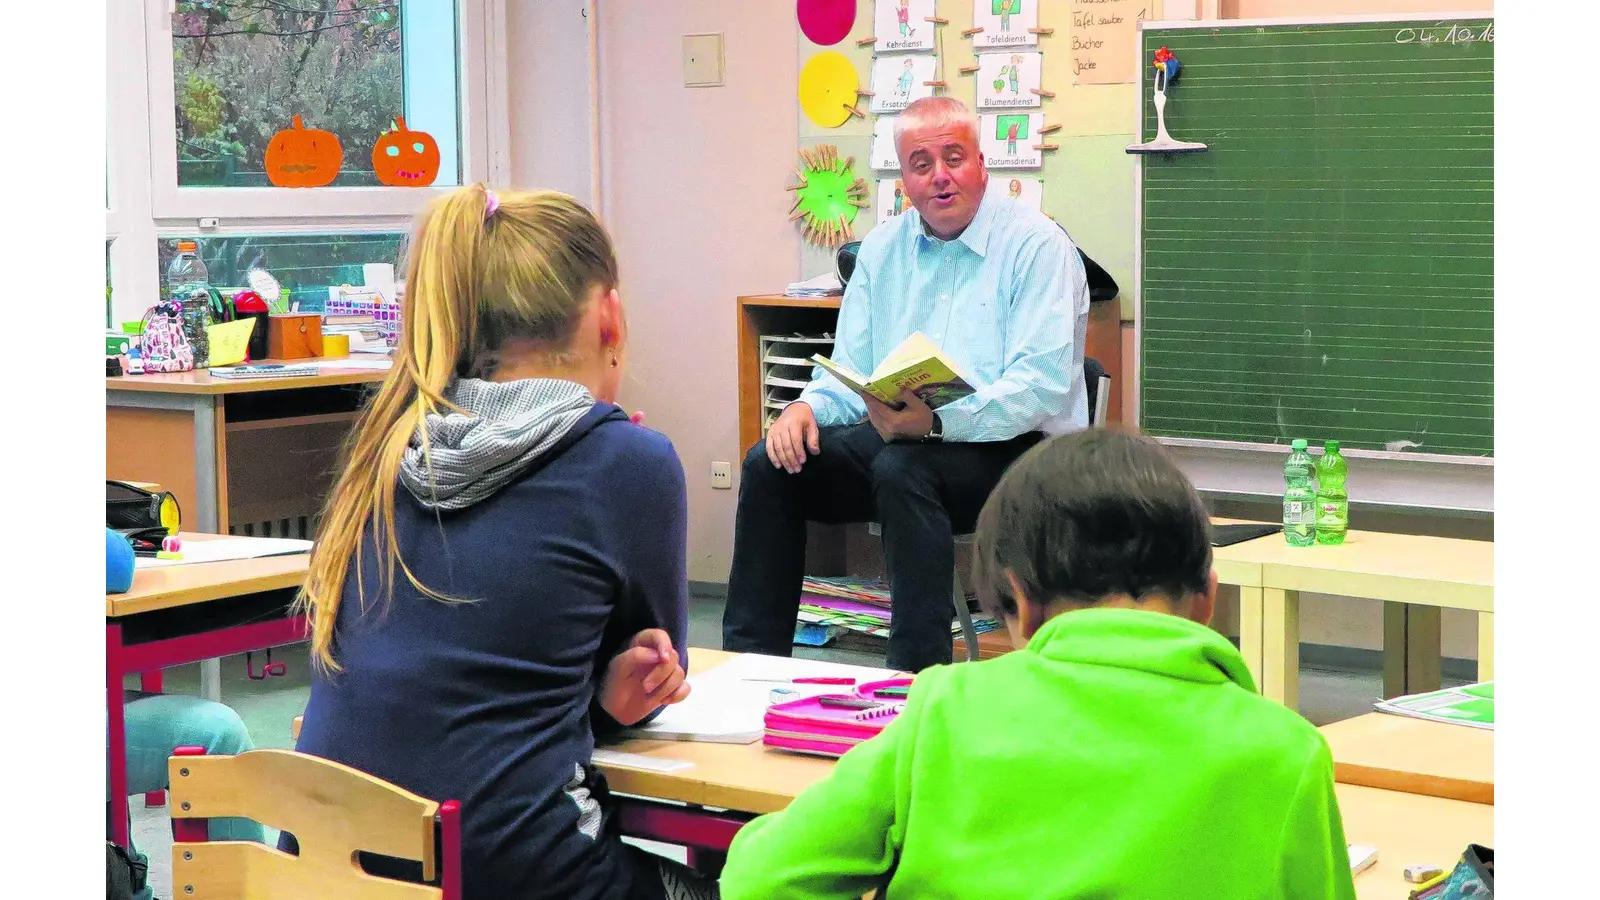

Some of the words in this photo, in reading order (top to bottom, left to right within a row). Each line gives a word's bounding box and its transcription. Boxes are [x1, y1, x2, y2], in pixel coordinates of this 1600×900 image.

[1072, 10, 1095, 29] Tafel
[1097, 12, 1124, 26] sauber
[986, 35, 1027, 44] Tafeldienst
[886, 40, 923, 49] Kehrdienst
[1072, 57, 1097, 76] Jacke
[984, 98, 1034, 107] Blumendienst
[988, 157, 1036, 166] Datumsdienst
